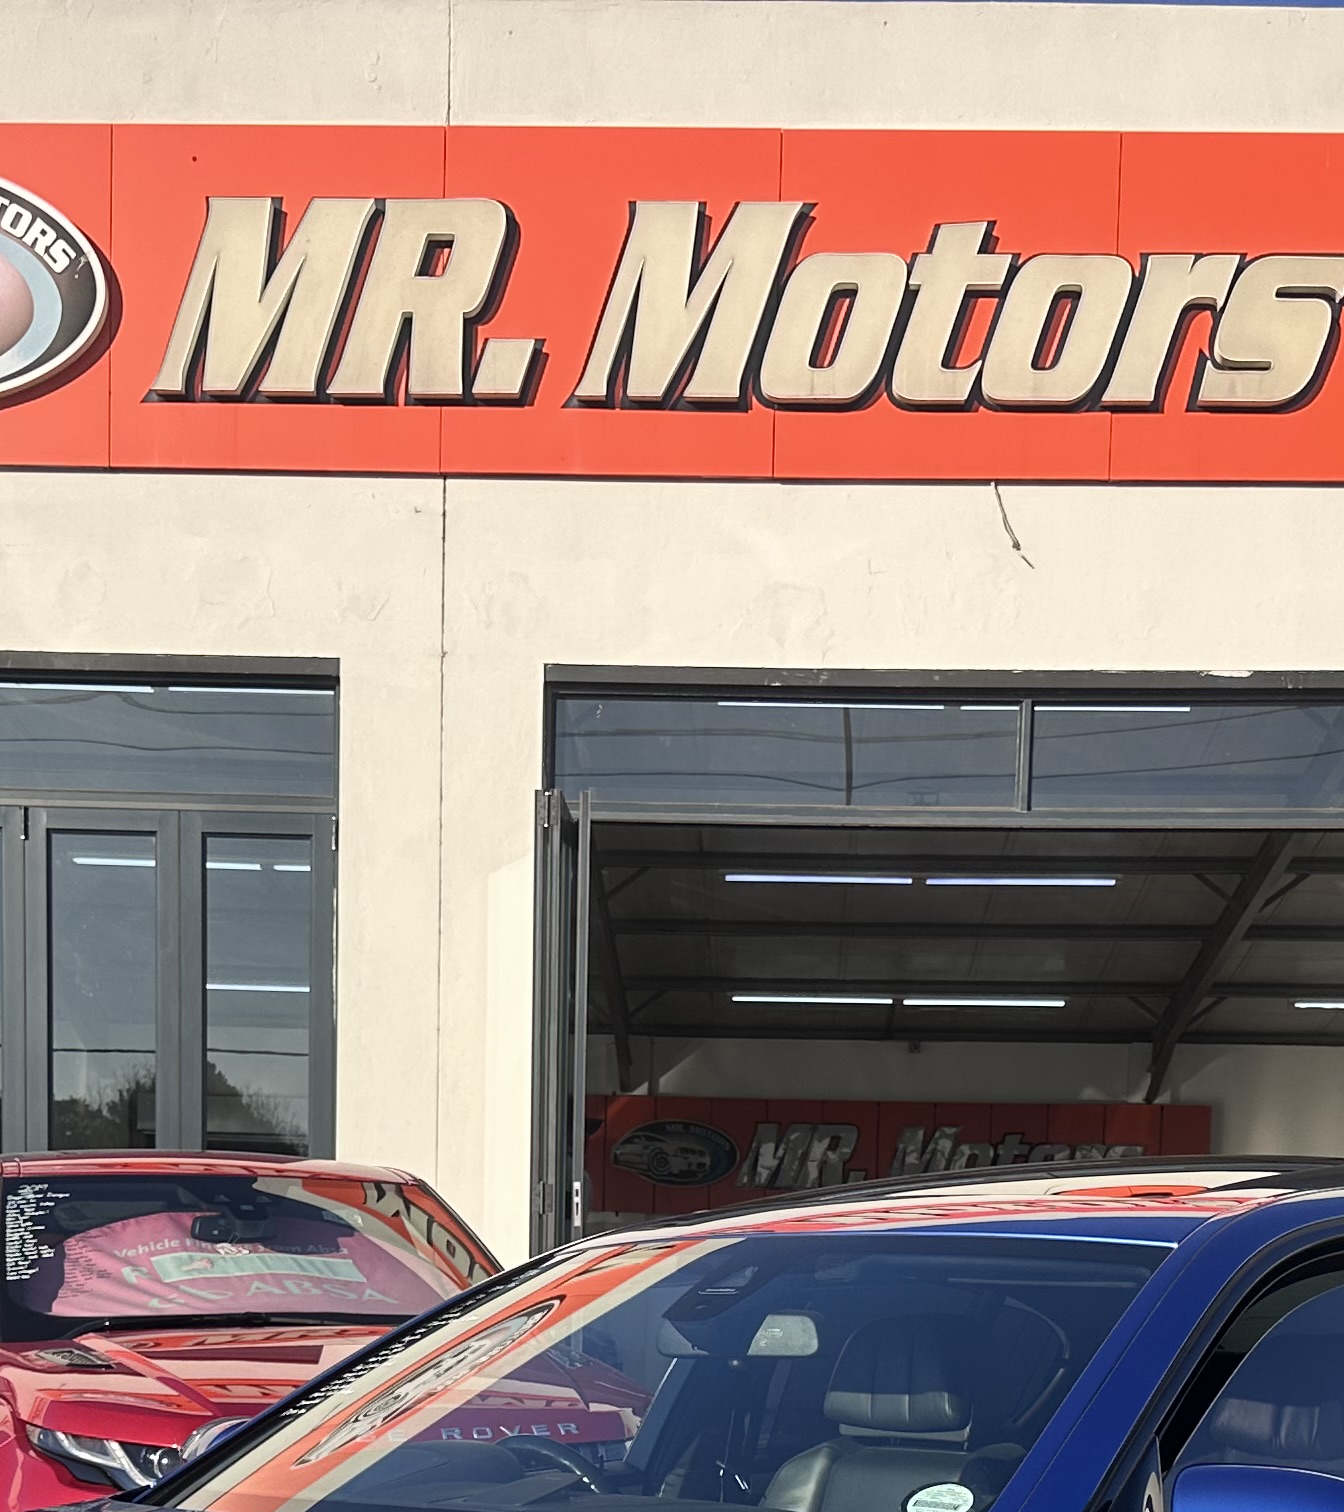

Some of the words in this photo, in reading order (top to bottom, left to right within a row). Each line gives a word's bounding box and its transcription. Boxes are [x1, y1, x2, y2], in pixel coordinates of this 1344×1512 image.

[148, 196, 545, 404] MR.
[113, 1238, 181, 1258] Vehicle
[246, 1279, 399, 1305] ABSA
